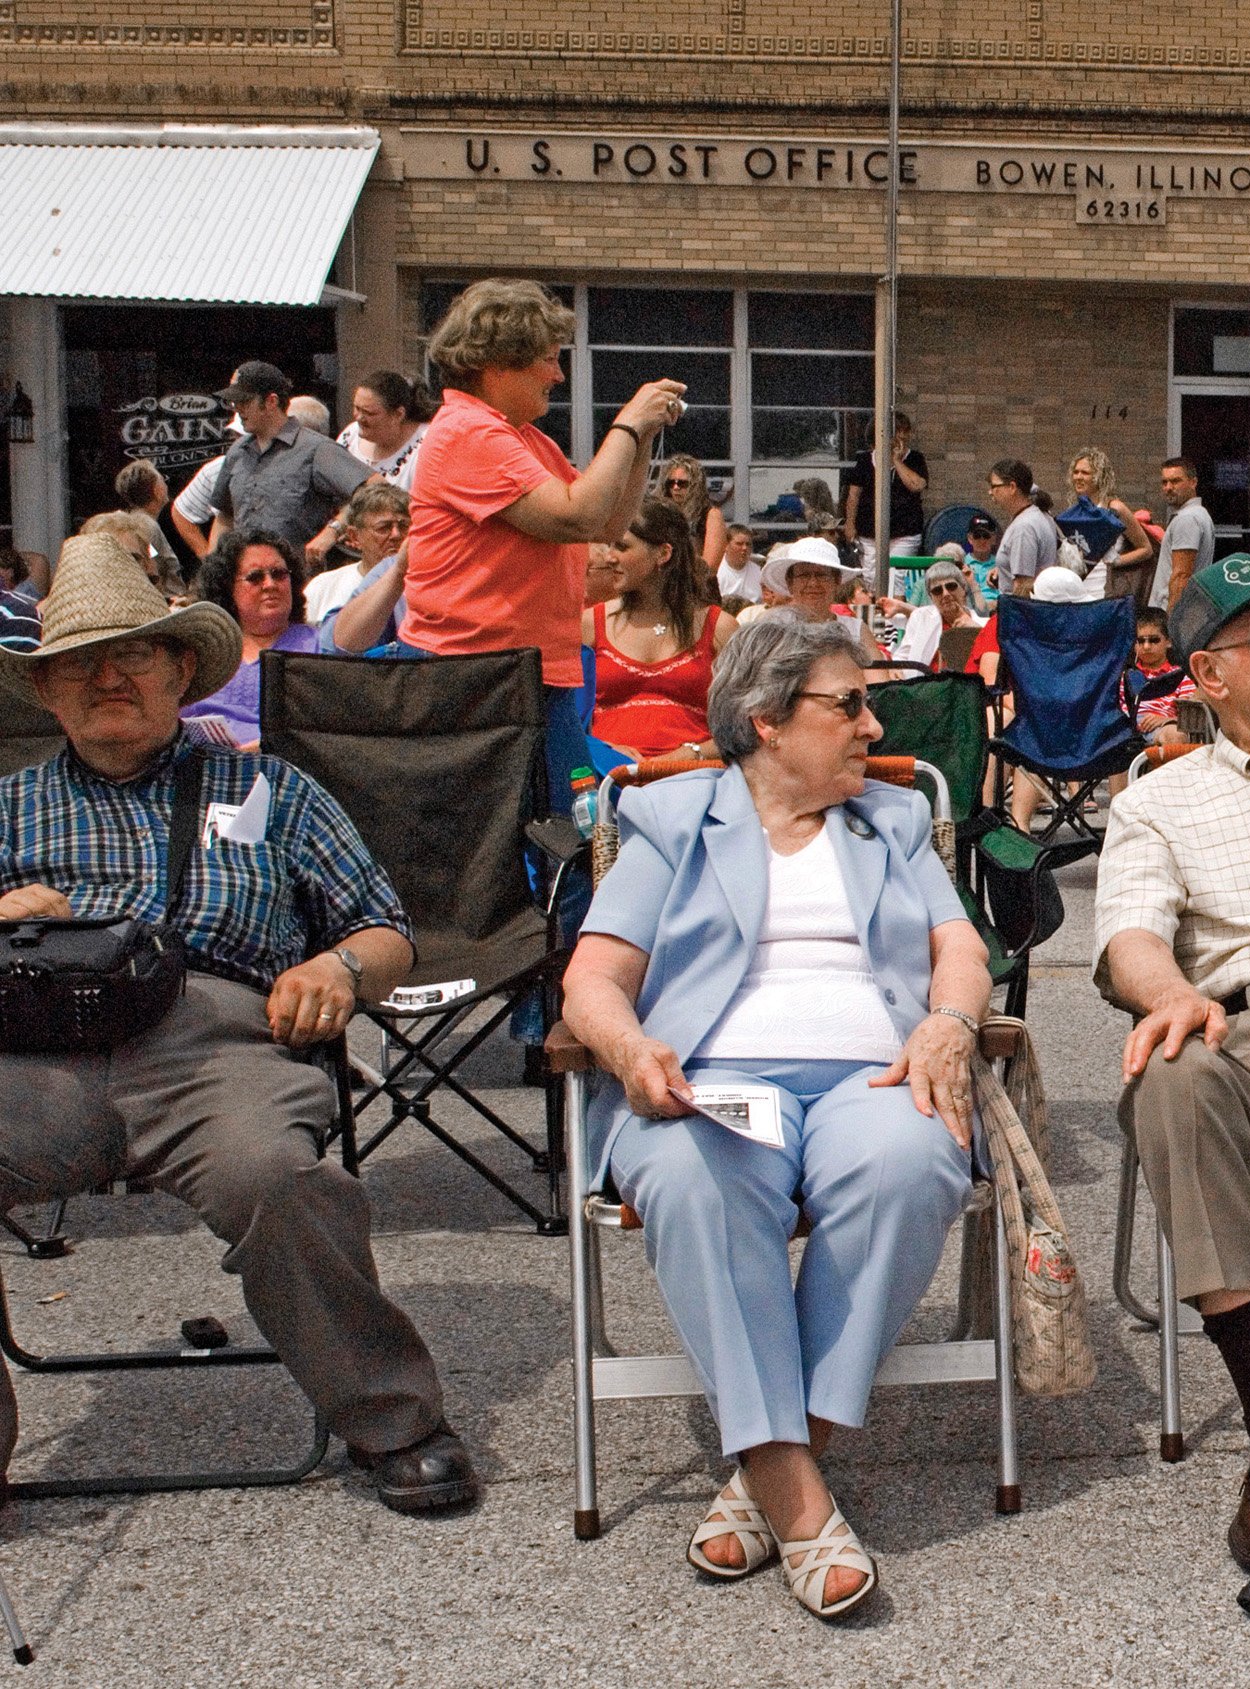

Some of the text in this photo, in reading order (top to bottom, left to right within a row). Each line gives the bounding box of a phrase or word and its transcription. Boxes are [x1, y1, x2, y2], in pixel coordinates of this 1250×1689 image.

[465, 139, 918, 184] U. S. POST OFFICE
[1086, 200, 1159, 219] 62316
[170, 397, 208, 410] Brian
[1091, 404, 1128, 421] 114
